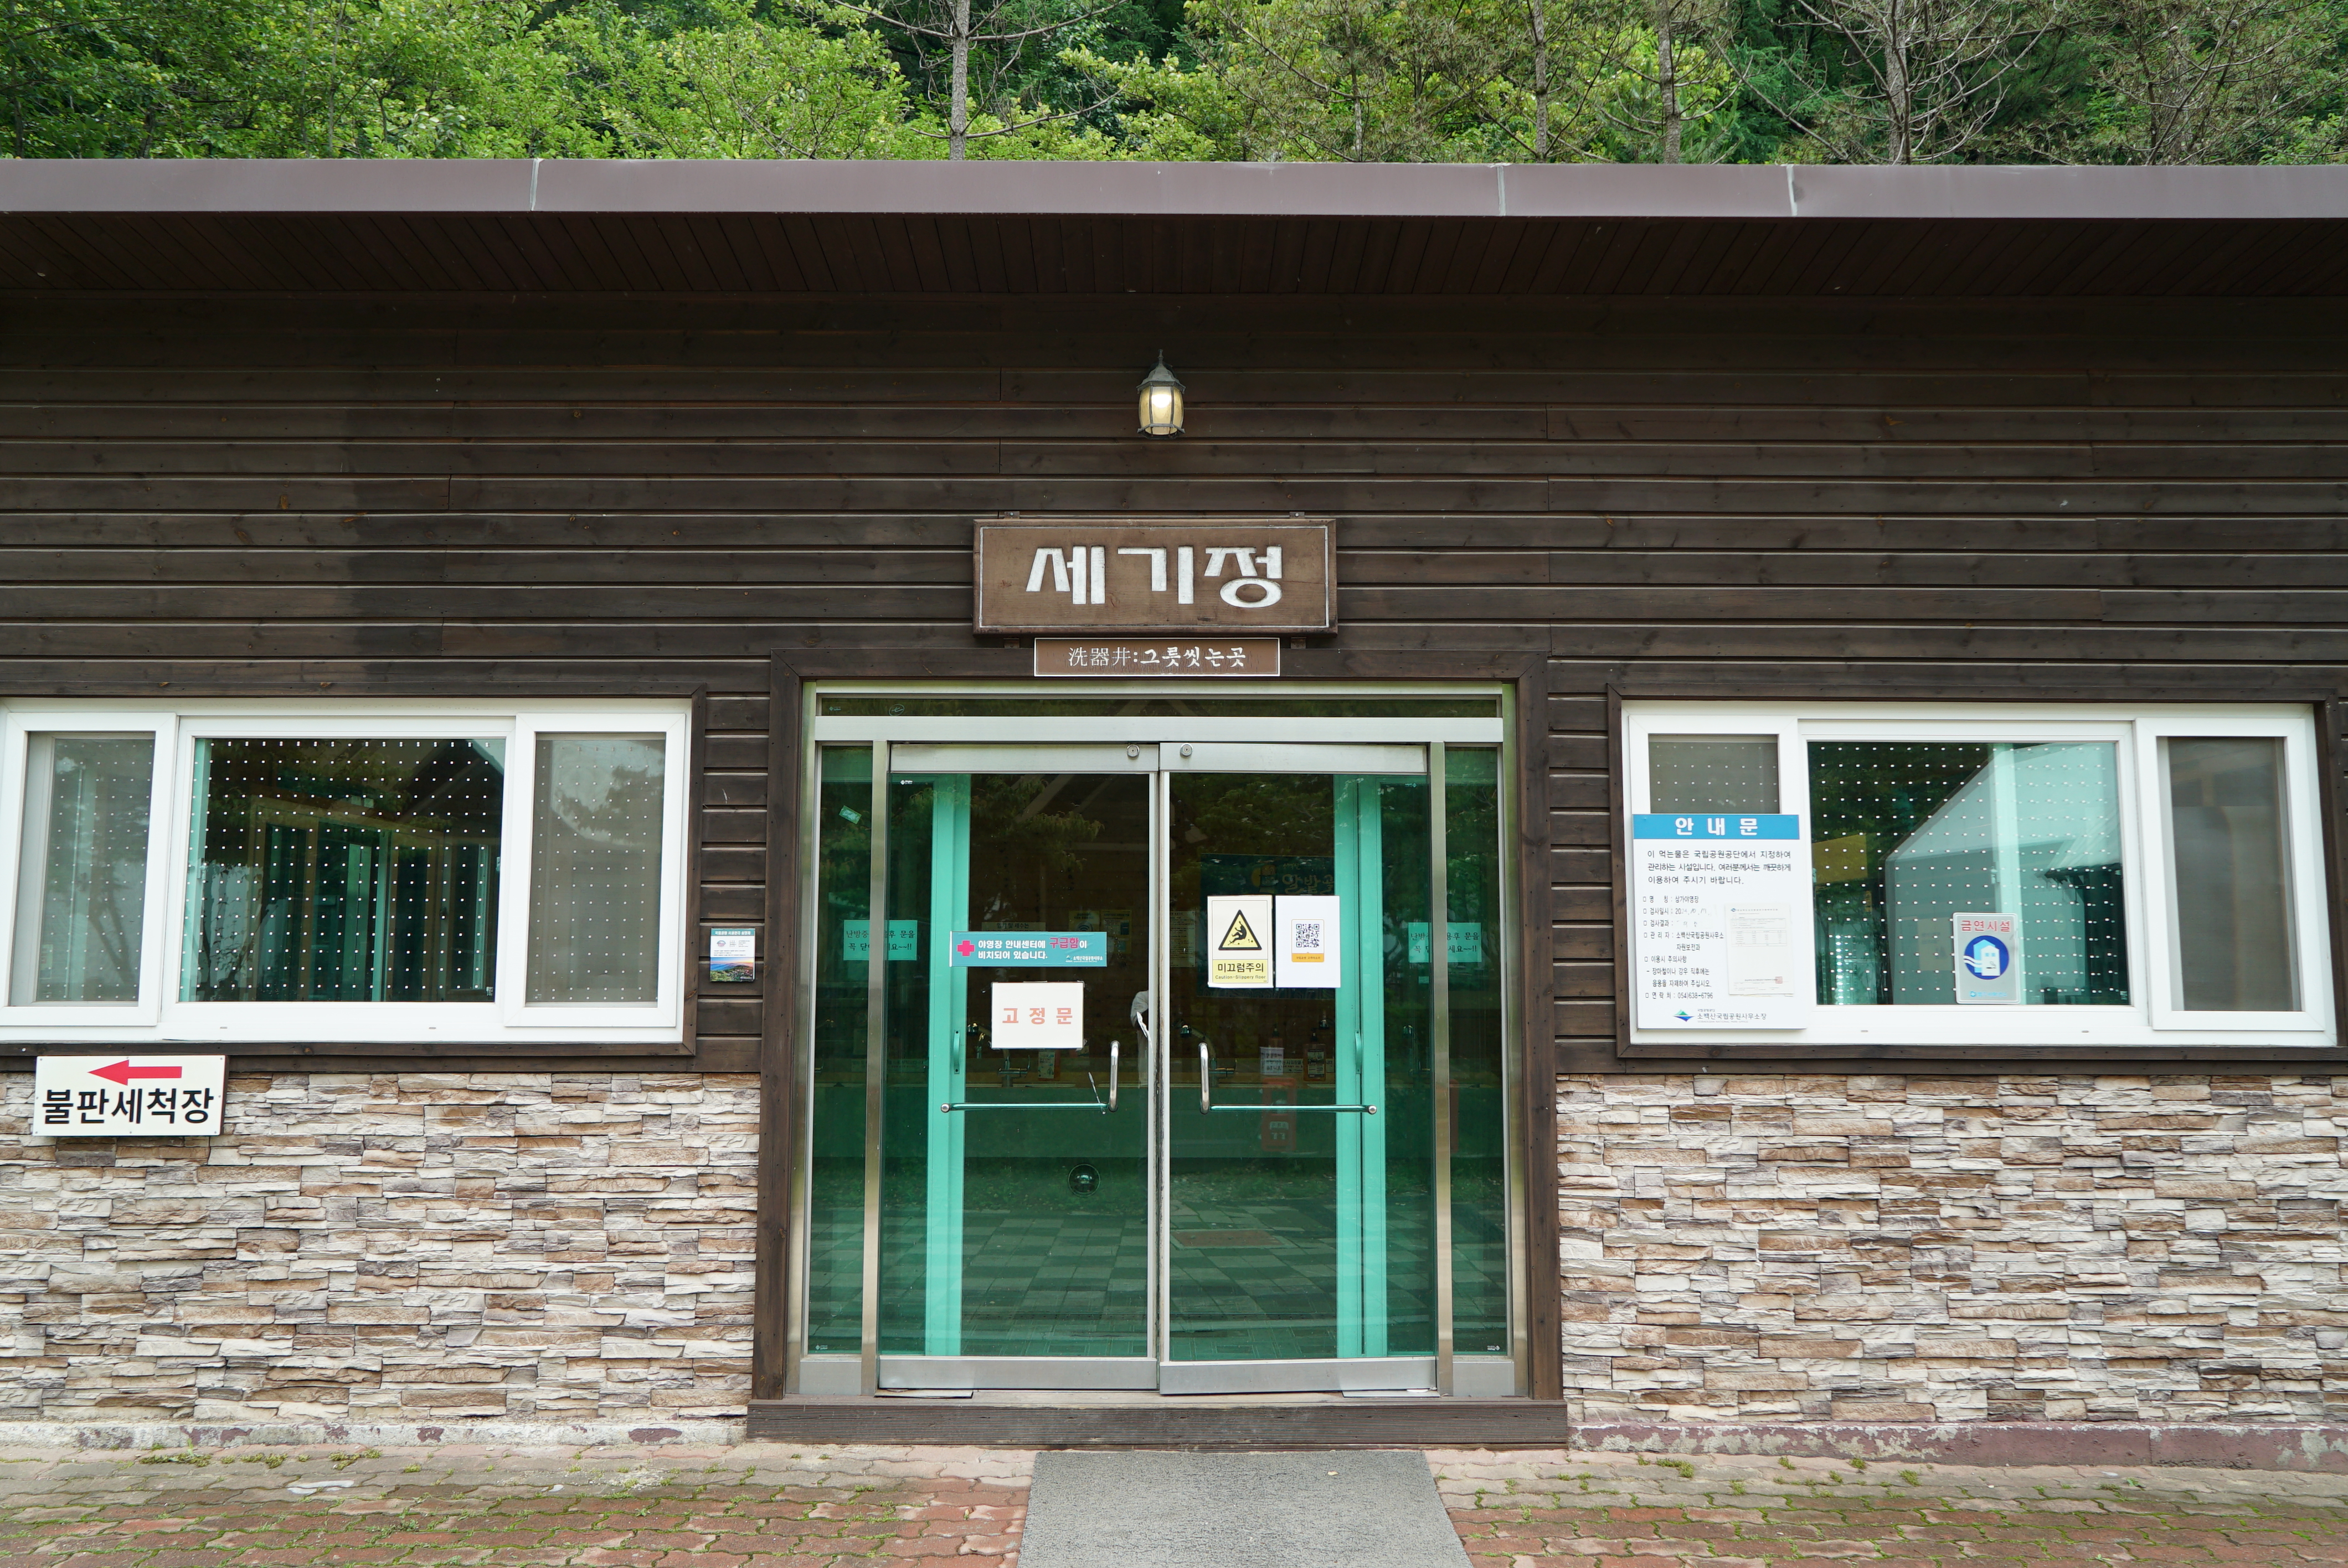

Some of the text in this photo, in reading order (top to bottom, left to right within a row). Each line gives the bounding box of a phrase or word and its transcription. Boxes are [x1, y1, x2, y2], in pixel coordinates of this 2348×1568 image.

[1026, 545, 1283, 608] 세기정
[1659, 850, 1690, 858] 먹는물은
[1693, 850, 1756, 859] 국립공원공단에서
[1760, 850, 1791, 859] 지정하여
[1647, 863, 1791, 871] 관리하는 시설입니다. 여러분께서는 깨끗하게
[1648, 876, 1744, 884] 이용하여 주시기 바랍니다.
[1960, 920, 2011, 932] 금연시설
[846, 930, 869, 938] 난방중
[900, 930, 915, 938] 문을
[1410, 932, 1428, 941] 난방
[978, 937, 1087, 949] 야영장 안내센터에 구급함이
[978, 951, 1048, 960] 비치되어 있습니다.
[1218, 962, 1264, 973] 미끄럼주의
[42, 1087, 214, 1124] 불판세척장
